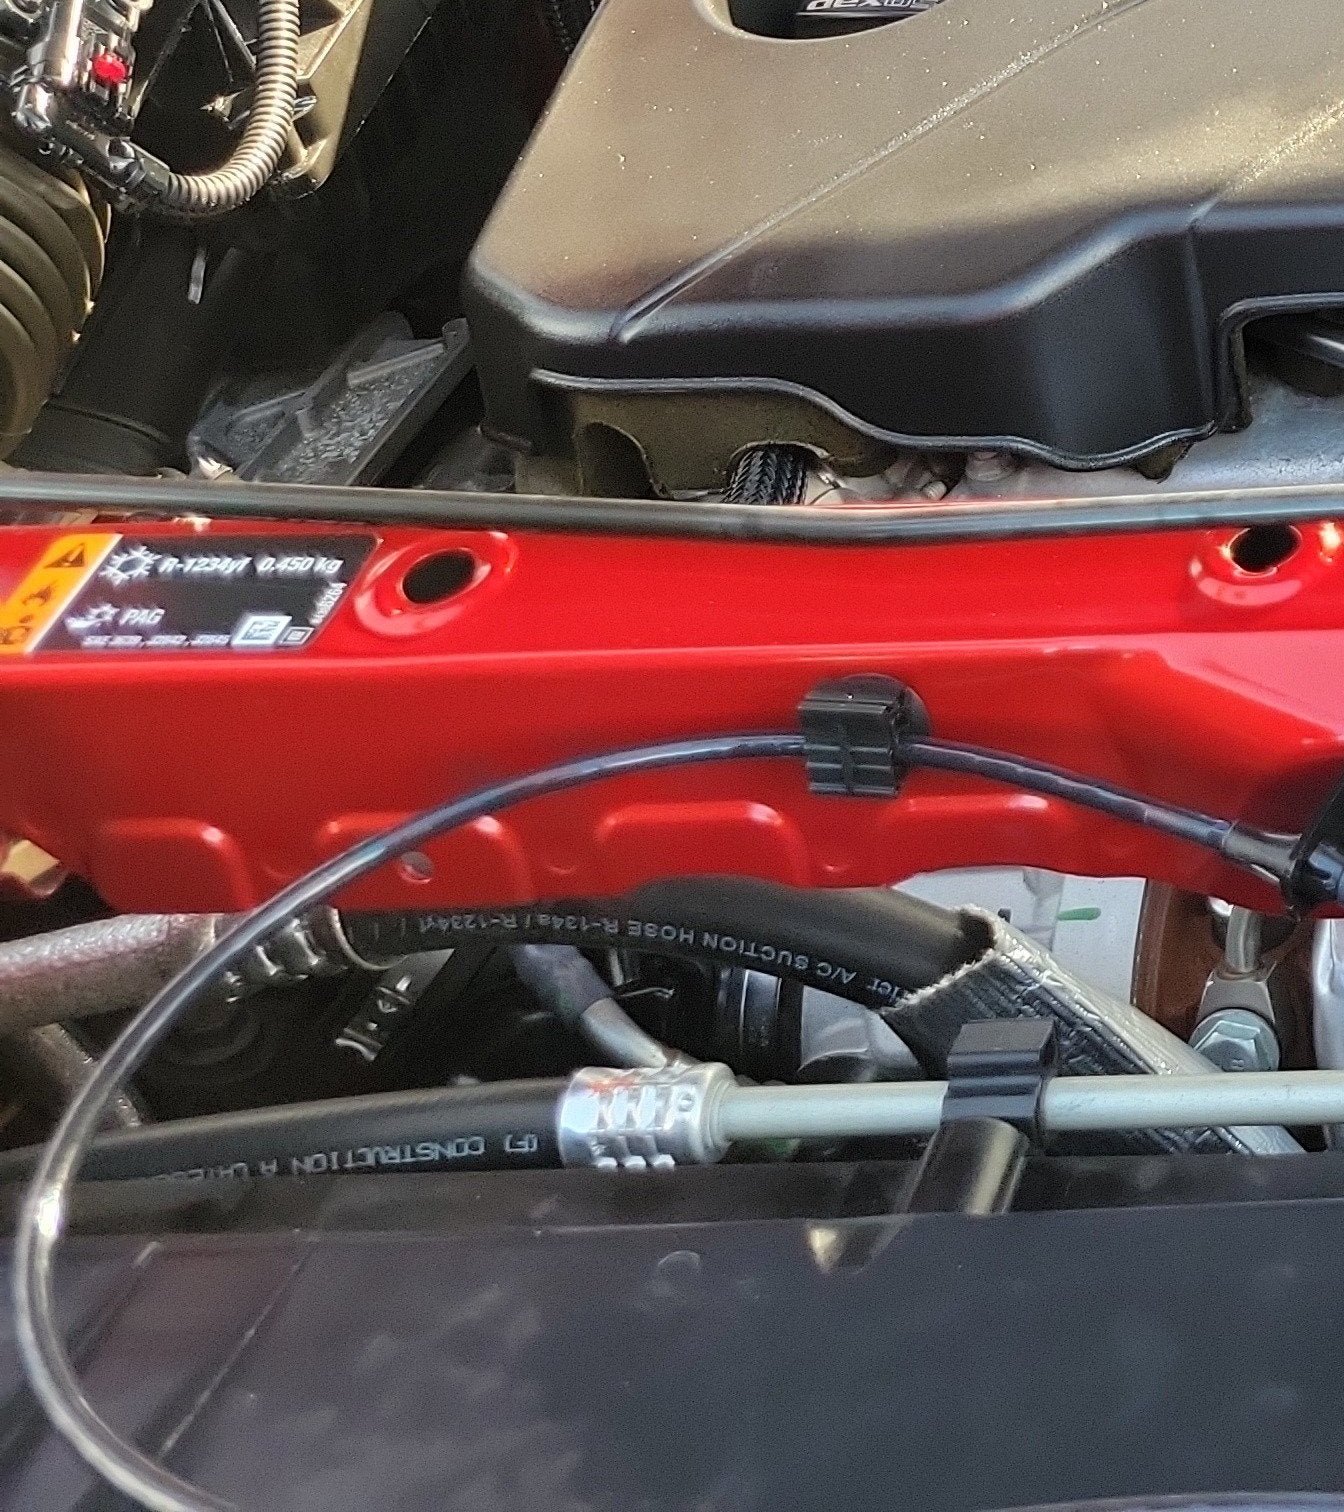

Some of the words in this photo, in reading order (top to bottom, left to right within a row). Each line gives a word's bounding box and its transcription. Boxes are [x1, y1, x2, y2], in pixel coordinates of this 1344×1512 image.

[156, 556, 252, 576] R-1234yf
[256, 556, 315, 573] 0.450
[314, 556, 345, 575] kg
[118, 607, 165, 626] PAG
[537, 912, 620, 935] R-134a
[626, 918, 696, 945] HOSE
[701, 930, 811, 972] SUCTION
[815, 959, 857, 986] A/C
[290, 1134, 487, 1177] CONSTRUCTION
